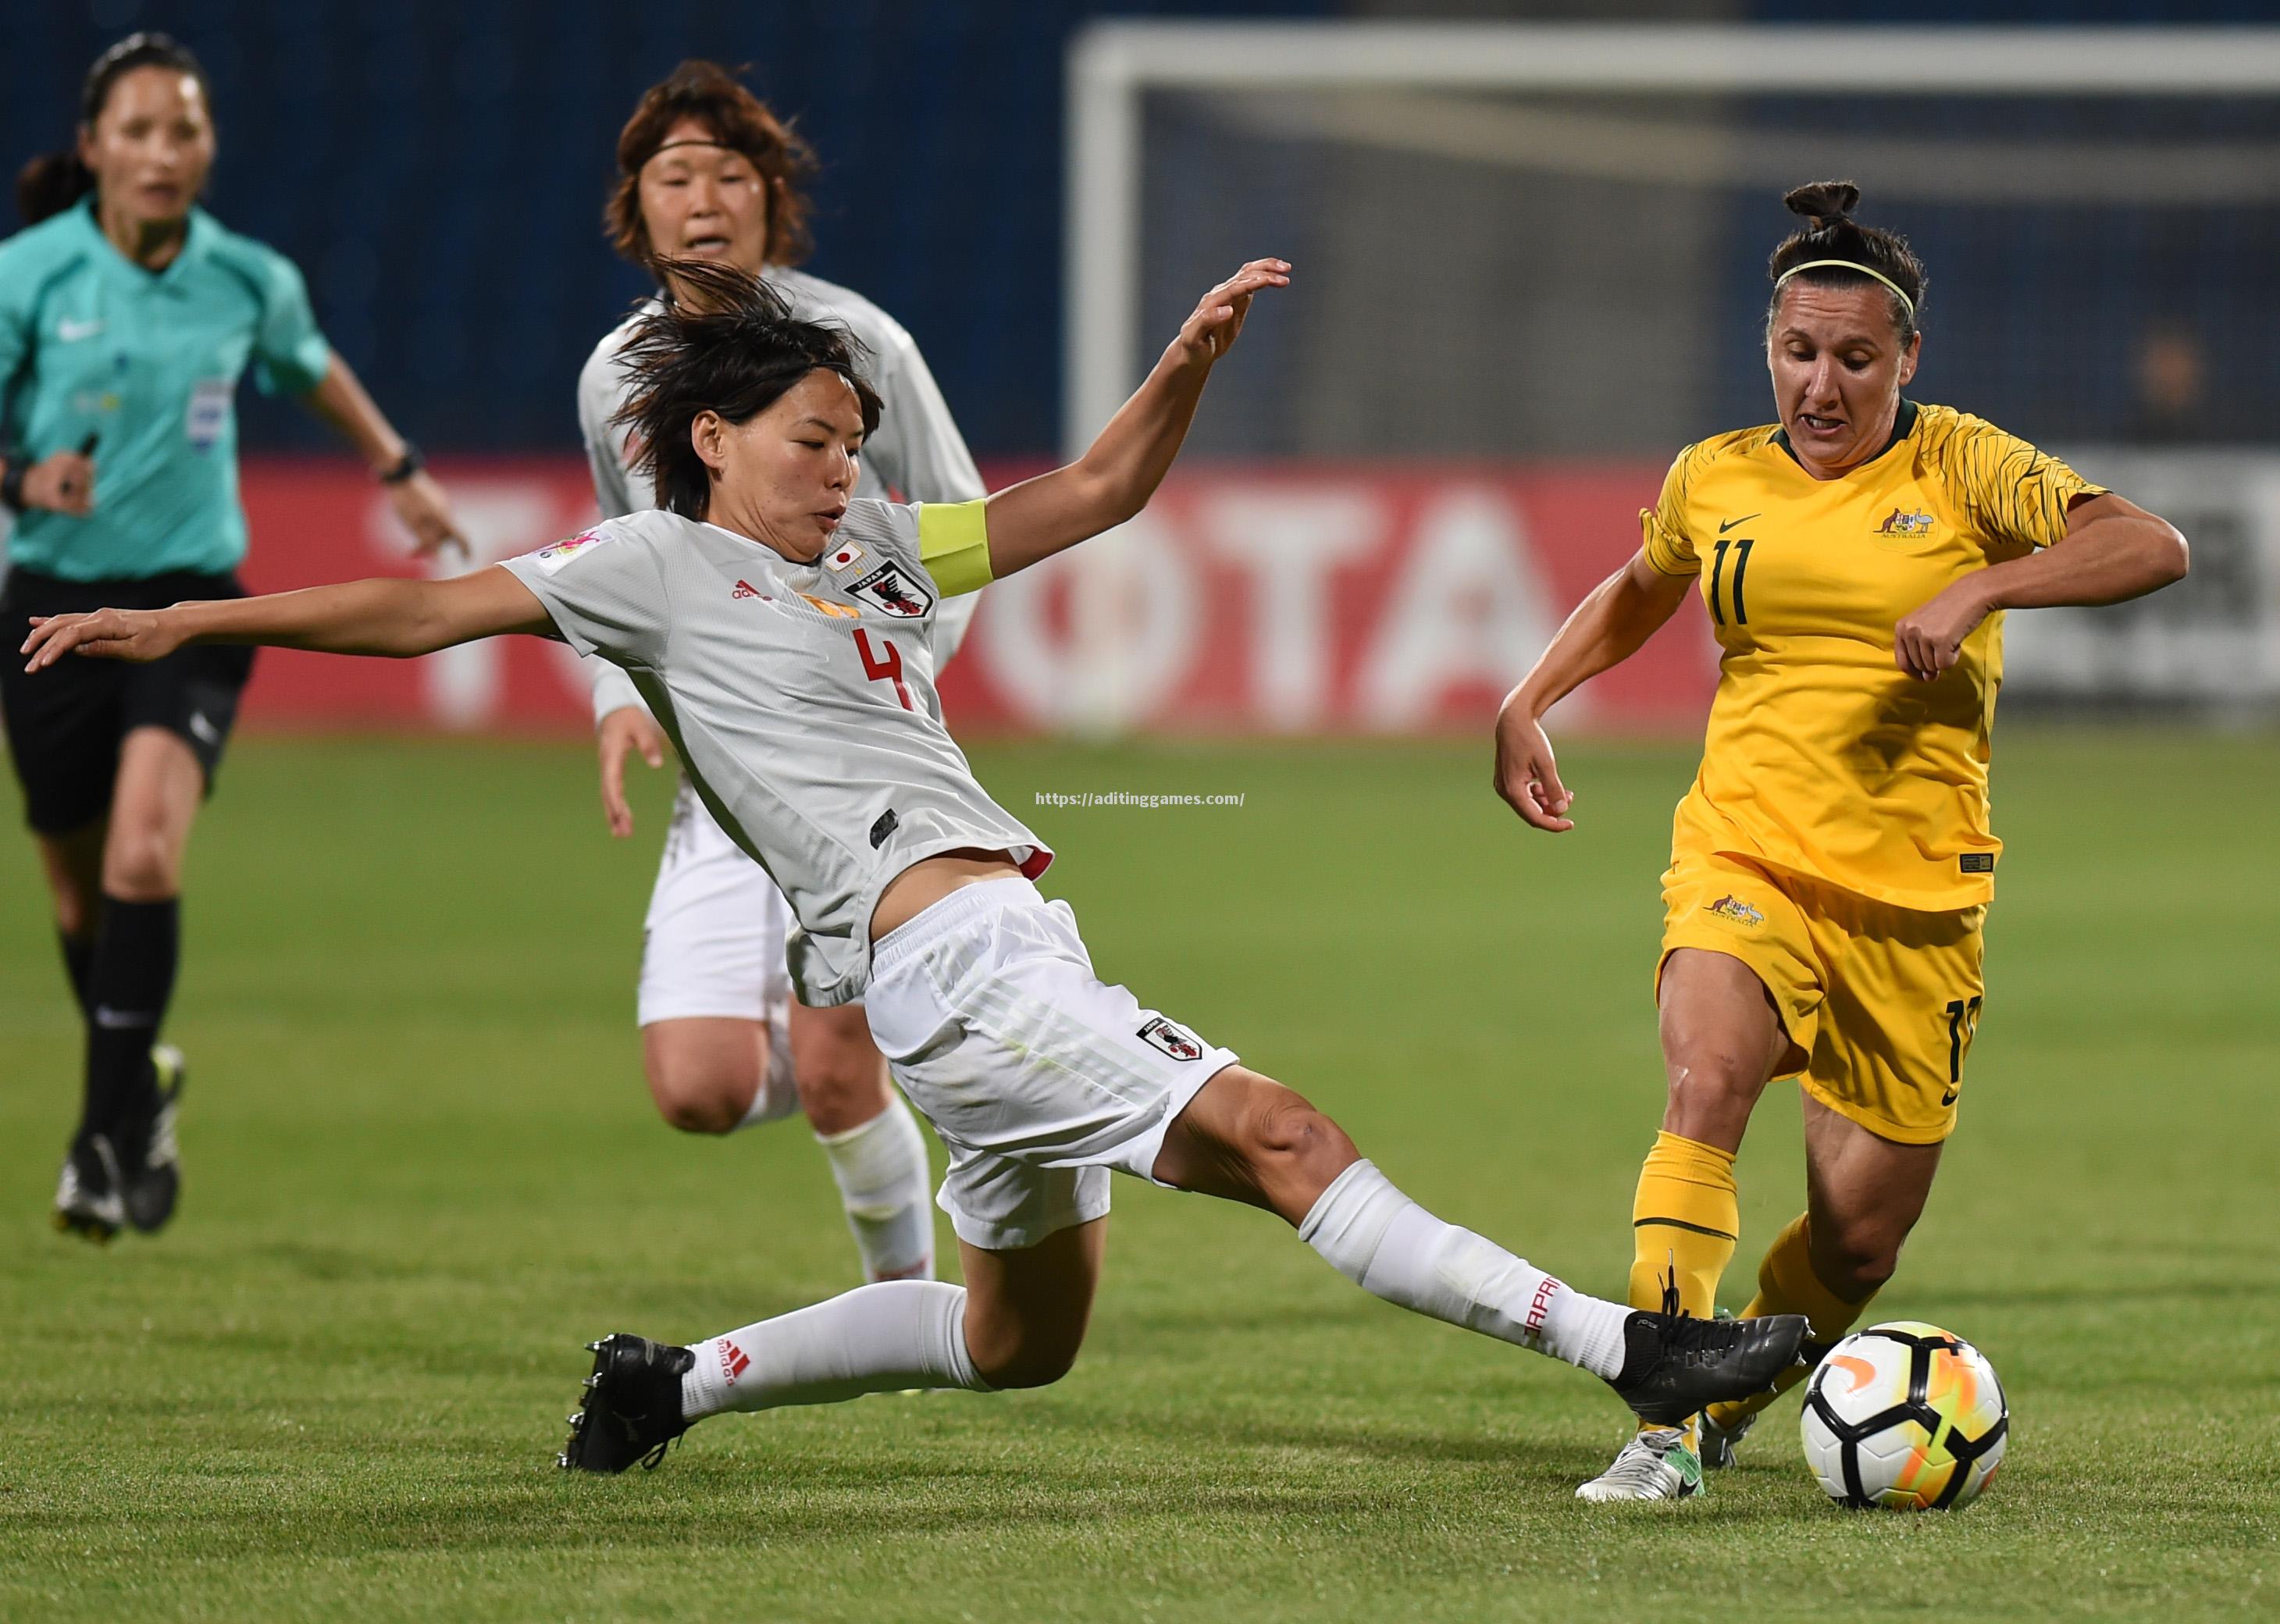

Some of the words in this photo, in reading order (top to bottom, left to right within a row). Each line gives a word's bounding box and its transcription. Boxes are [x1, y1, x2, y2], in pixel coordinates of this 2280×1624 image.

[857, 569, 884, 589] JAPAN
[1711, 539, 1755, 625] 11
[852, 628, 914, 711] 4
[717, 1338, 736, 1387] adidas
